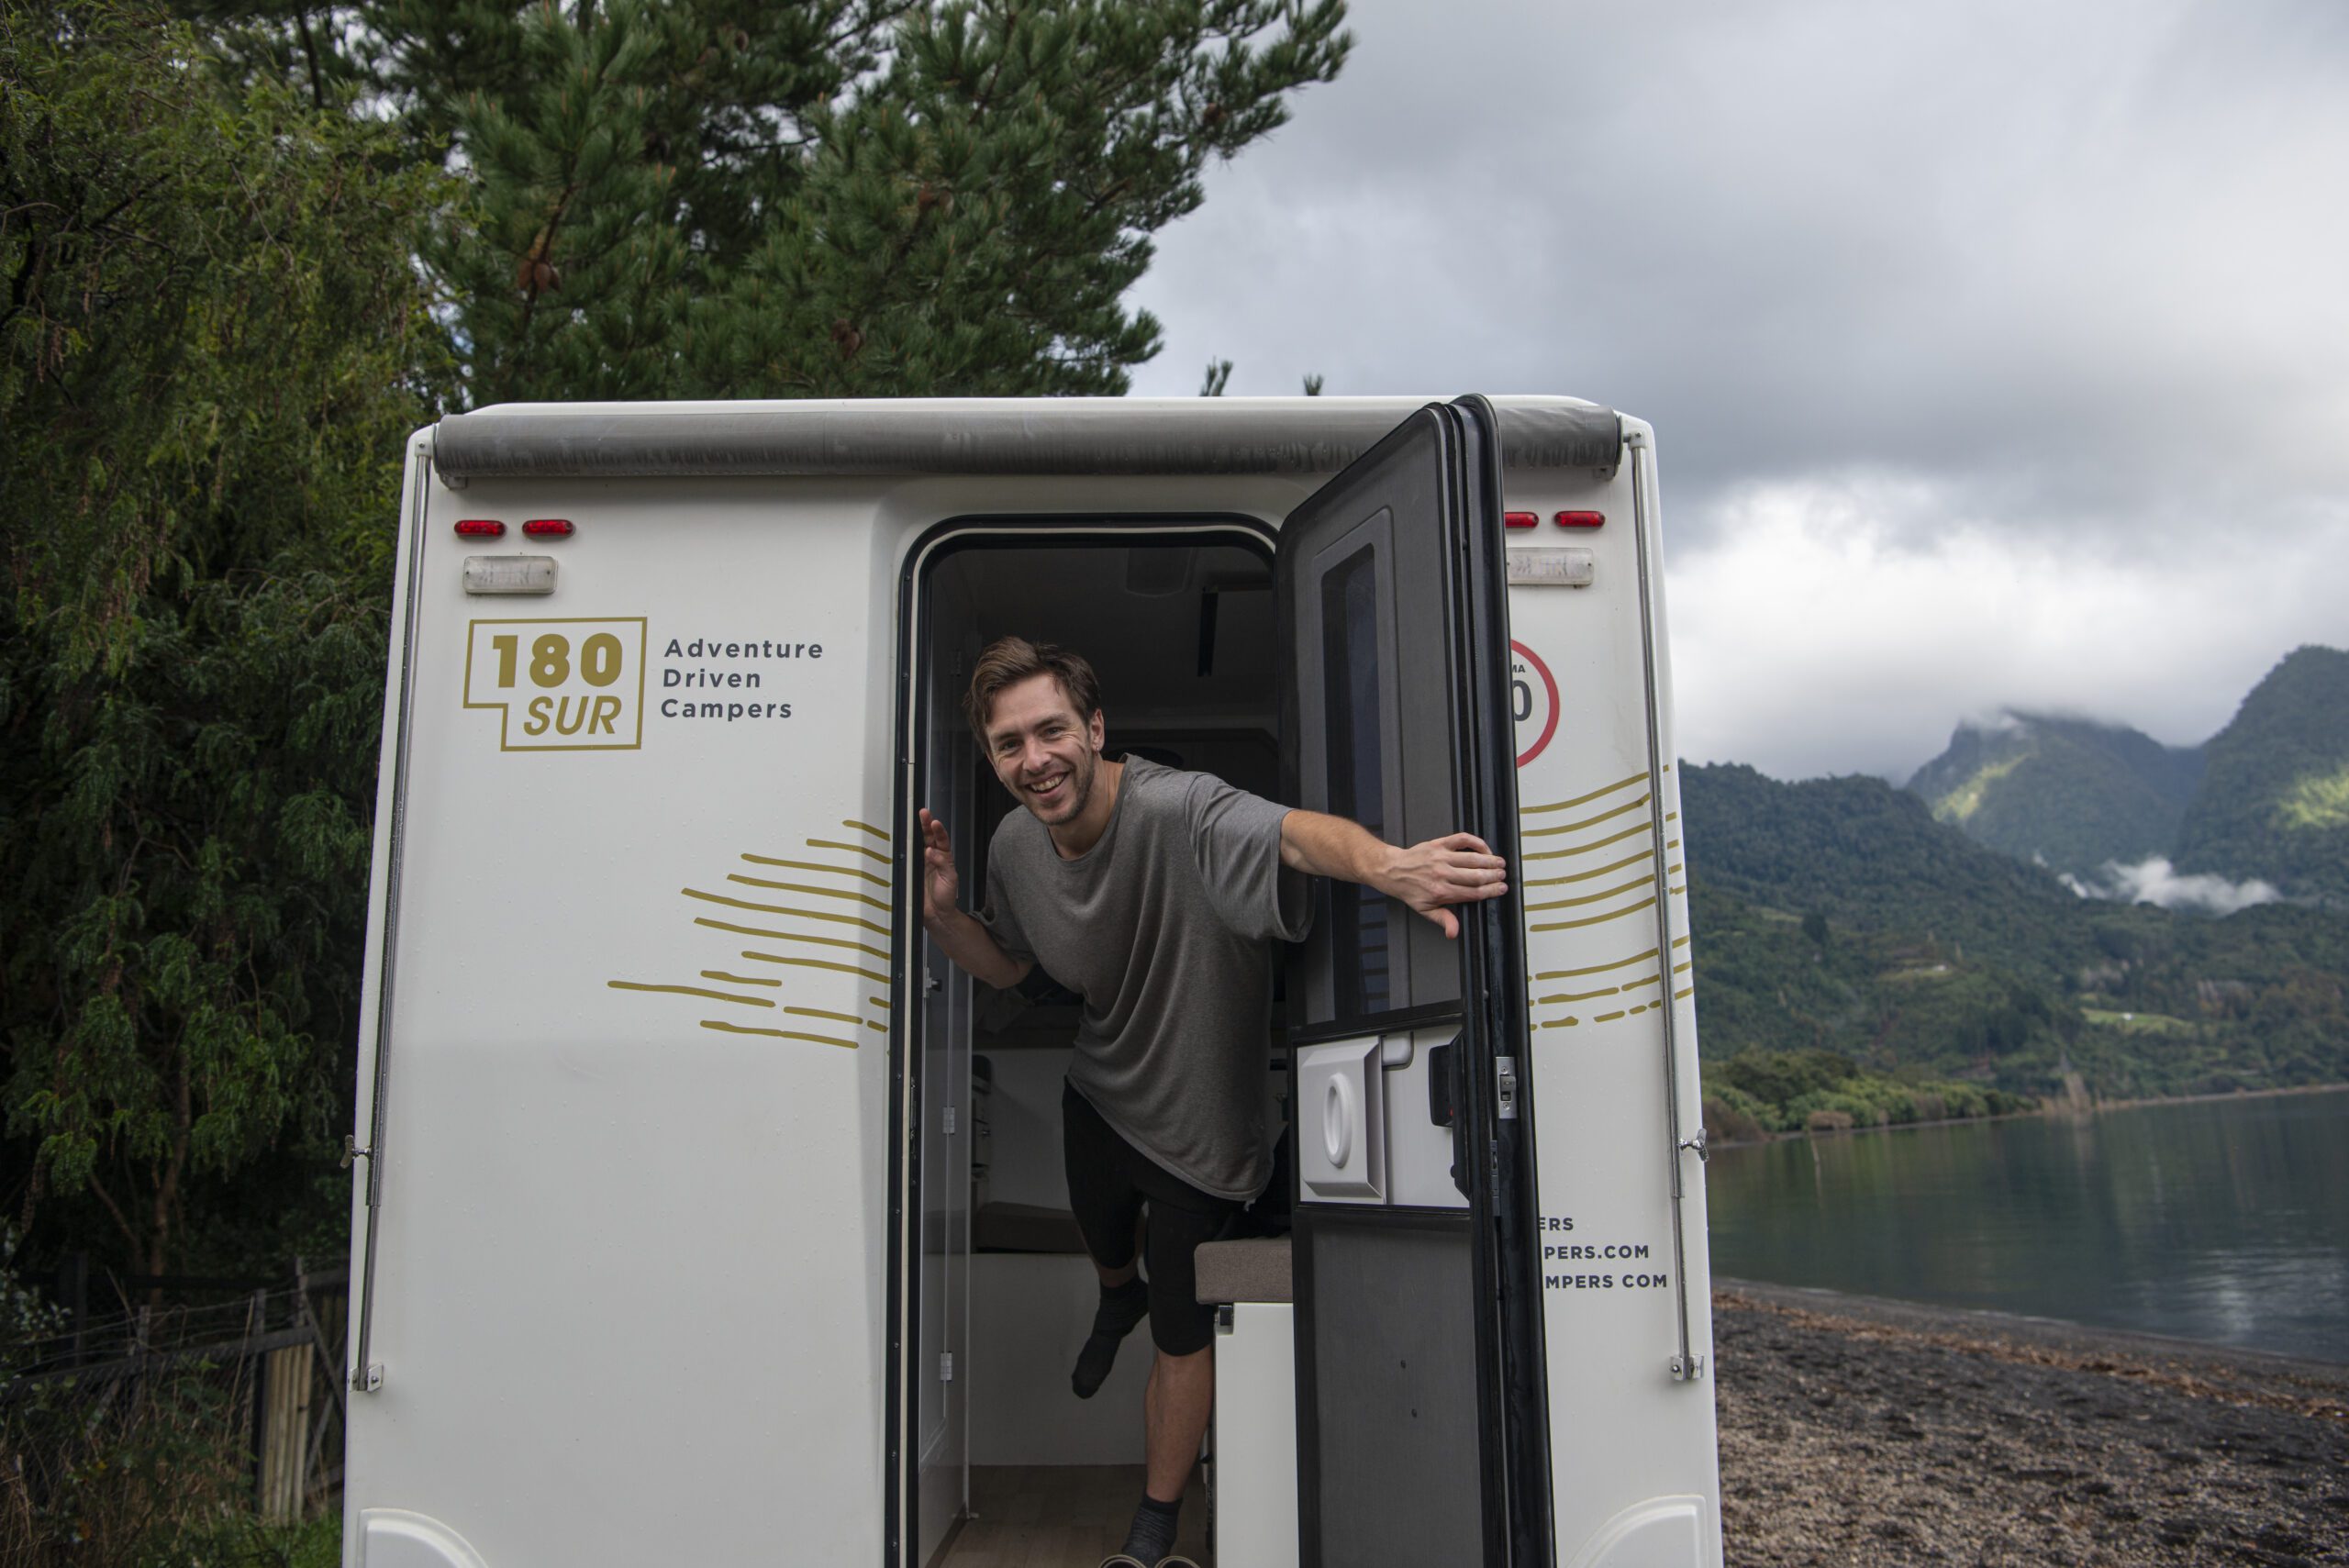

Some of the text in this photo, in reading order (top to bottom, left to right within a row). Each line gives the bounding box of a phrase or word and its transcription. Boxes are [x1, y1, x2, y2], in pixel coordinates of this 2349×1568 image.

[664, 639, 823, 659] Adventure
[493, 633, 622, 687] 180
[662, 669, 761, 688] Driven
[524, 696, 622, 736] SUR
[661, 699, 792, 721] Campers
[1544, 1245, 1649, 1260] PERS.COM
[1545, 1274, 1667, 1289] MPERS COM
